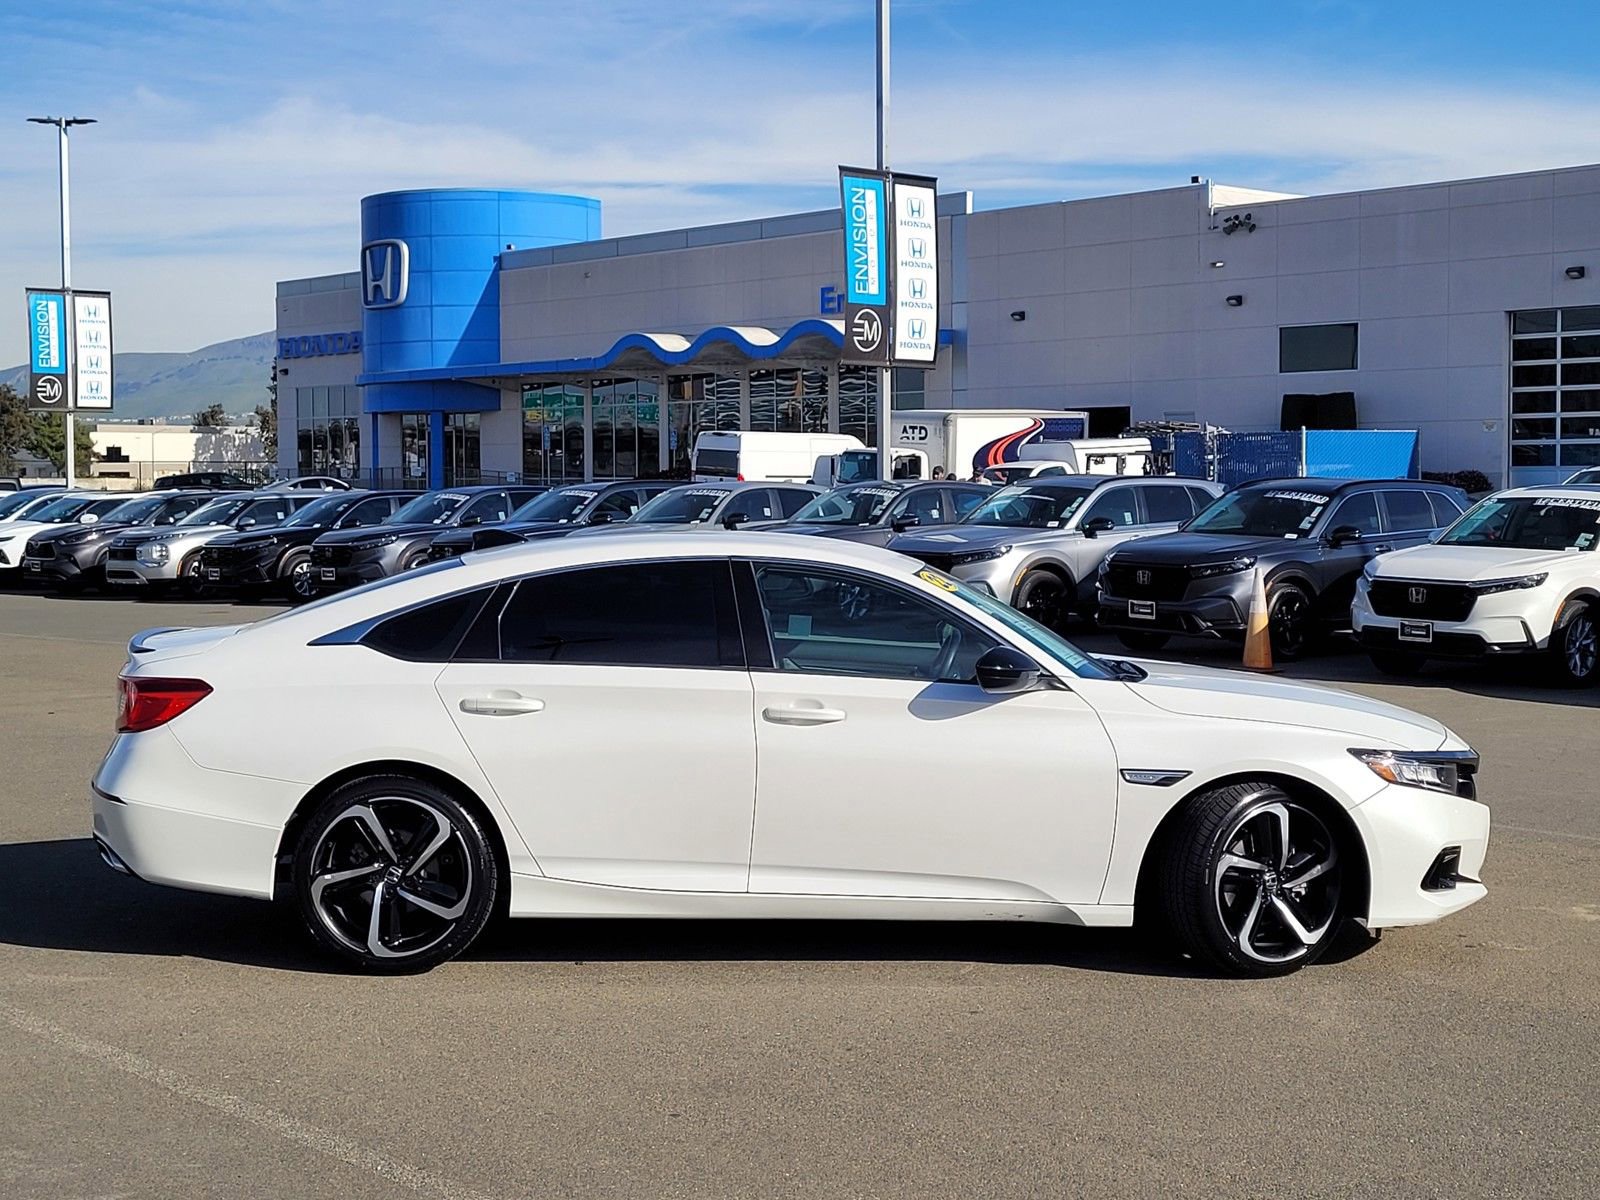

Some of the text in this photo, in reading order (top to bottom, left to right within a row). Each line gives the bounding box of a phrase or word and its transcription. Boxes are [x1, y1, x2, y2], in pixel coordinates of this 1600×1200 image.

[900, 220, 932, 230] HONDA
[851, 187, 869, 294] ENVISION
[900, 260, 933, 270] HONDA
[900, 300, 933, 310] HONDA
[36, 300, 51, 367] ENVISION
[278, 331, 362, 359] HONDA
[899, 341, 932, 350] HONDA
[900, 424, 928, 441] ATD
